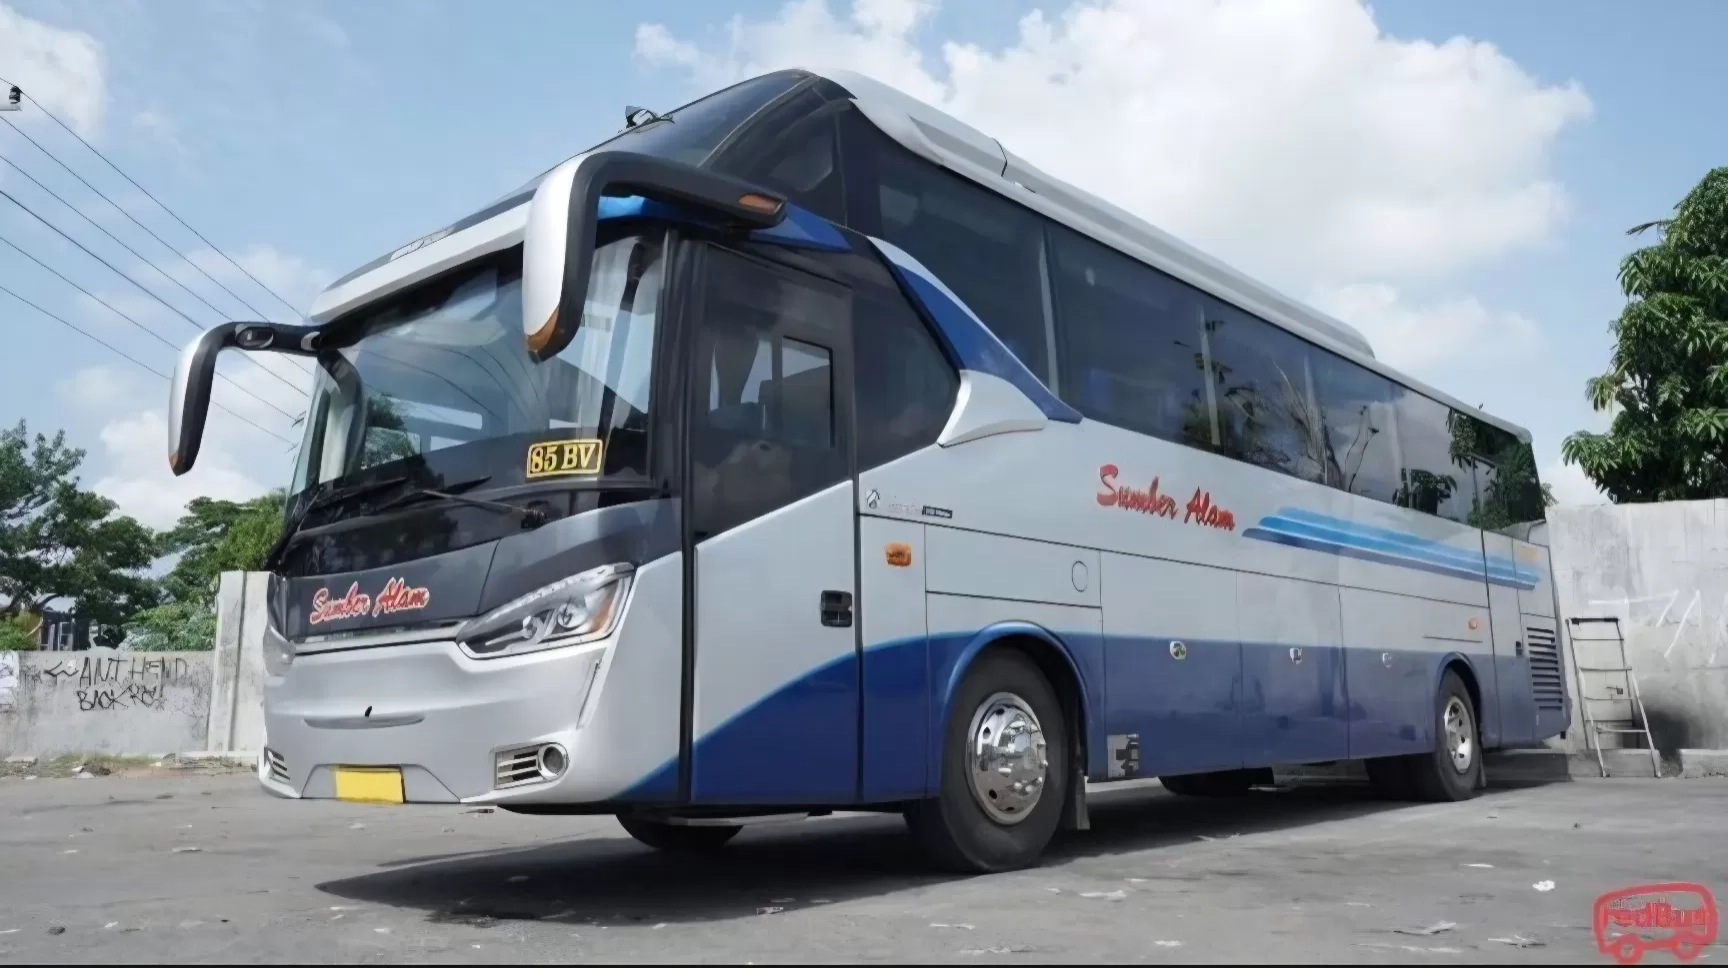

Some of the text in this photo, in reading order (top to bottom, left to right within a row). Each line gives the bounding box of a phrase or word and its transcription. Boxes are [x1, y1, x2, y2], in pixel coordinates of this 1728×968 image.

[531, 443, 596, 472] 85 BV
[1096, 463, 1235, 531] Sumber Alam
[310, 577, 430, 624] Sumber Alam
